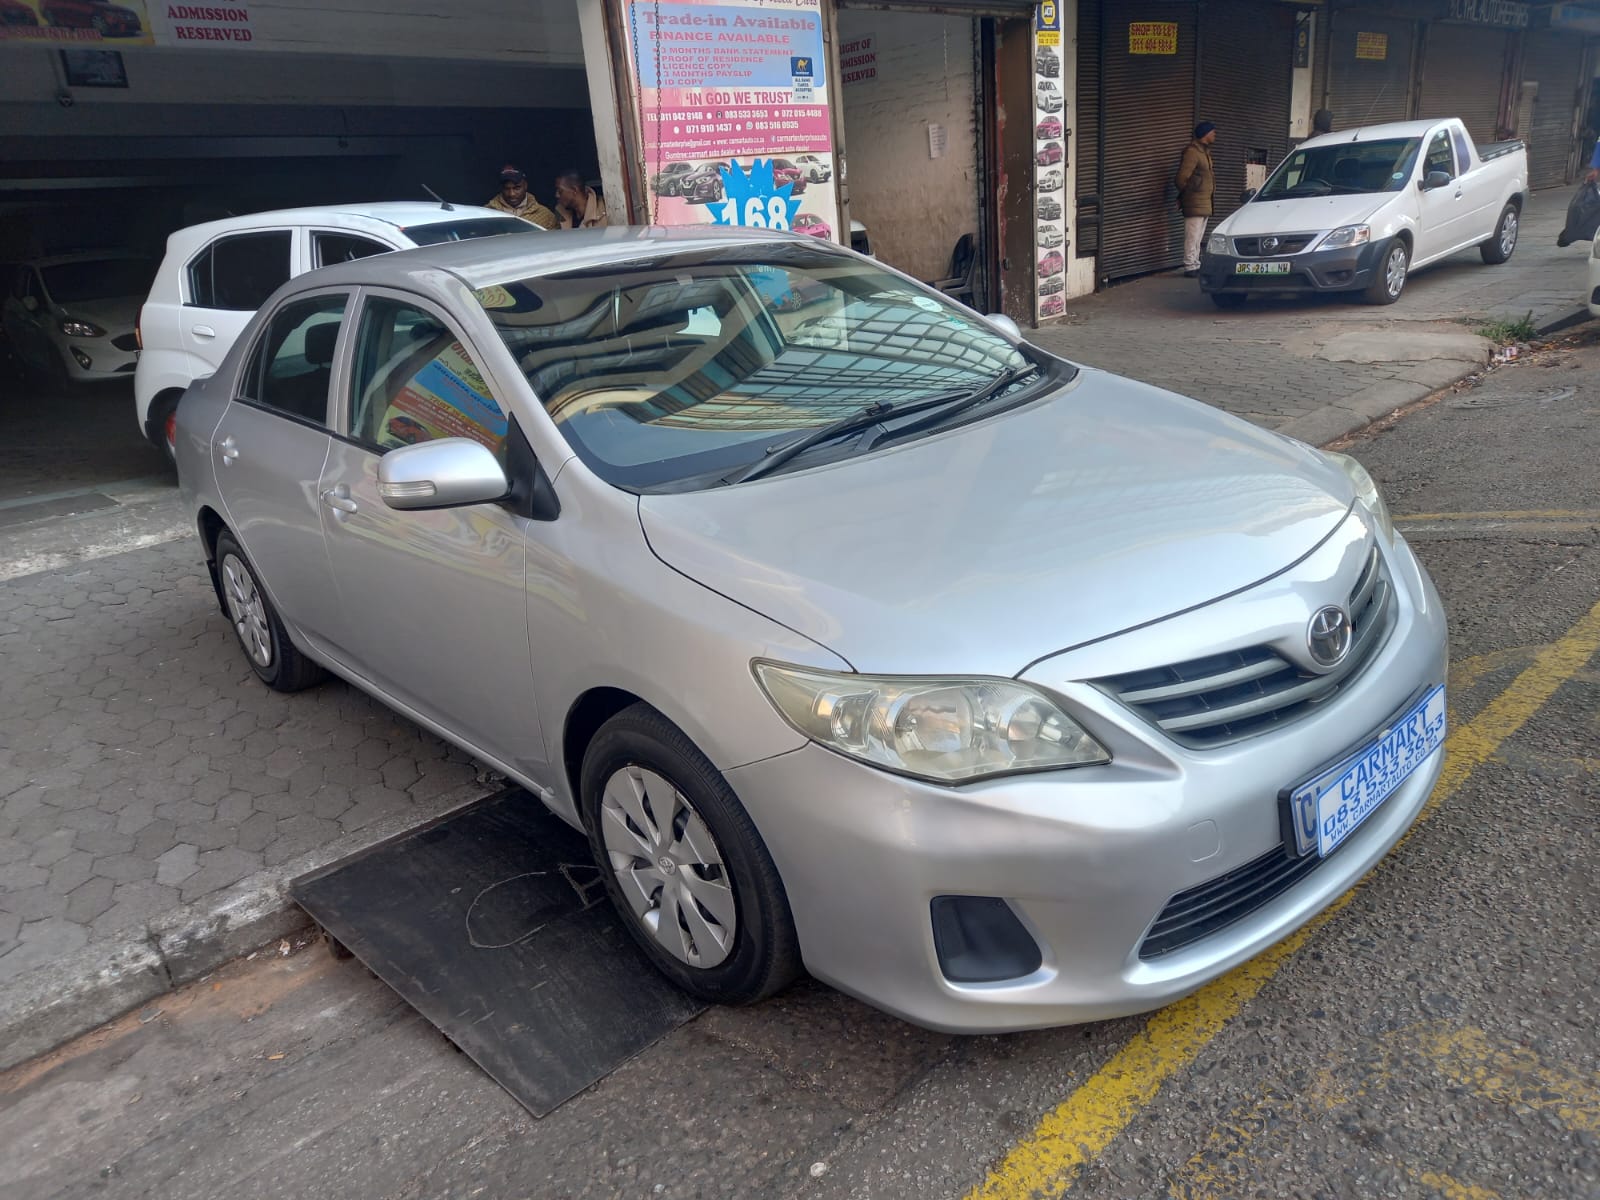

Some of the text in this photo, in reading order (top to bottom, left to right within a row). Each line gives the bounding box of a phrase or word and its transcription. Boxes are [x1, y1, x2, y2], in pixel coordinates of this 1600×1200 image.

[168, 6, 249, 21] ADMISSION
[642, 11, 816, 31] Trade-in Available
[176, 27, 253, 41] RESERVED
[718, 32, 790, 44] AVAILABLE
[861, 38, 872, 49] OF
[742, 48, 794, 56] STATEMENT
[705, 92, 731, 105] GOD
[733, 91, 752, 104] WE
[686, 124, 700, 134] 071
[700, 124, 714, 133] 910
[721, 195, 790, 231] 168
[1341, 704, 1429, 801] CARMART
[1324, 711, 1443, 836] 083 533 3653
